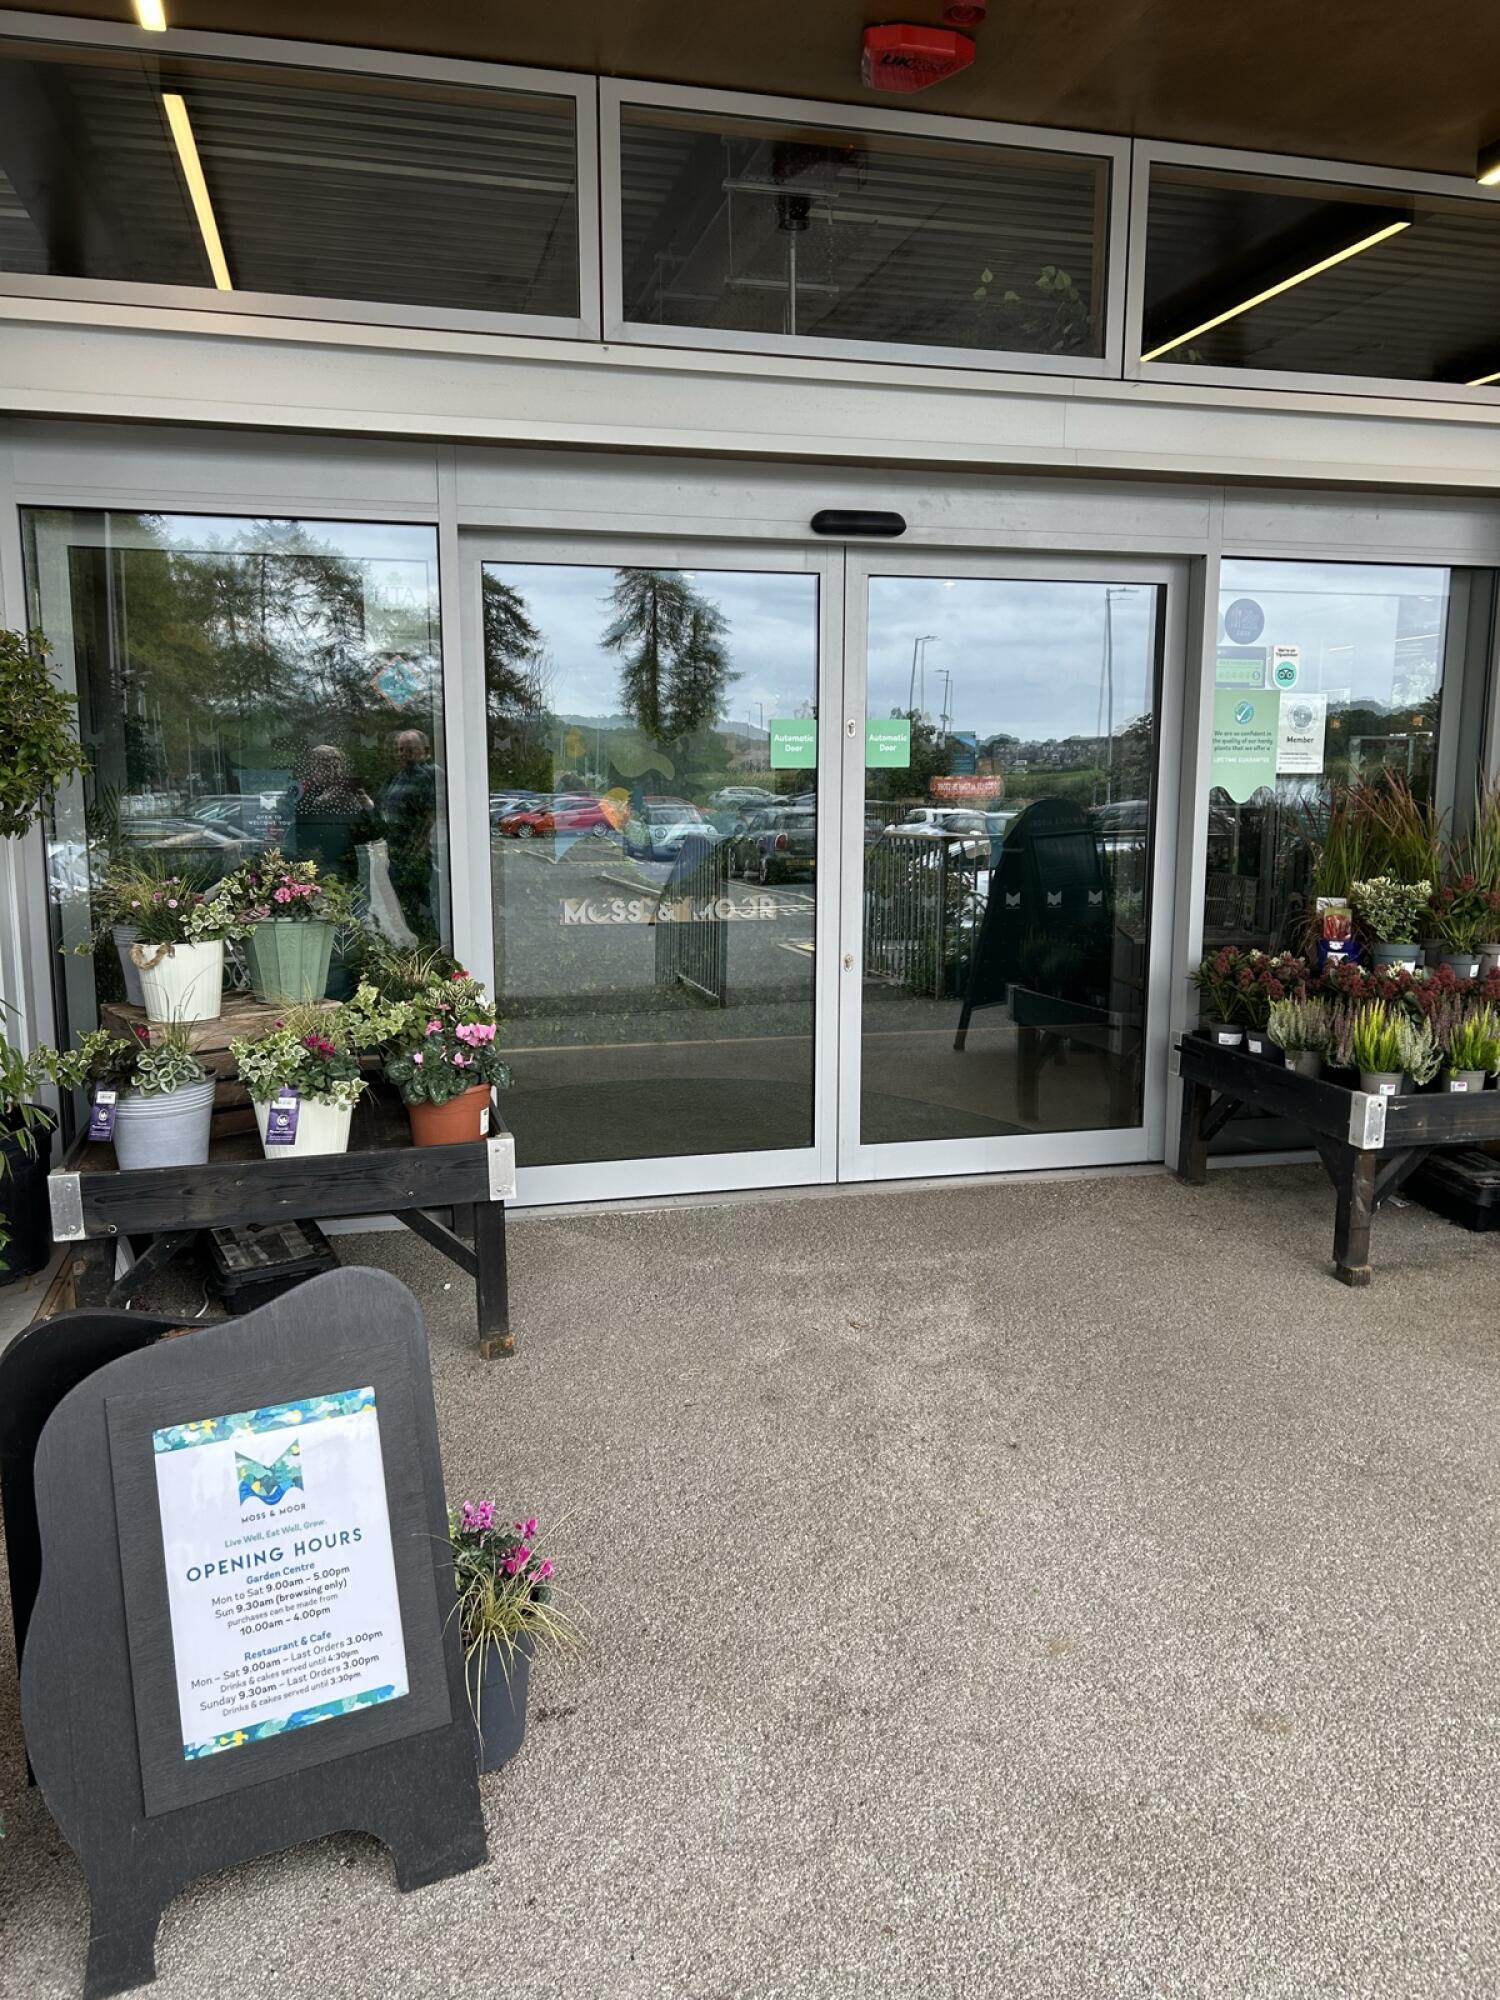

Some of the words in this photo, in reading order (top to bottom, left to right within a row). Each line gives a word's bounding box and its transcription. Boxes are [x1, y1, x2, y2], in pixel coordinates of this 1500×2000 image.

[774, 734, 814, 743] Automatic
[784, 744, 804, 752] Door
[869, 733, 907, 742] Automatic
[879, 743, 898, 752] Door
[1286, 736, 1315, 744] Member
[563, 900, 642, 922] MOSS
[241, 1511, 266, 1524] MOSS
[269, 1509, 276, 1518] &
[279, 1503, 306, 1515] MOOR
[224, 1539, 242, 1549] Live
[243, 1532, 265, 1544] Well,
[266, 1528, 280, 1539] Eat
[281, 1523, 303, 1535] Well,
[186, 1547, 284, 1582] OPENING
[294, 1528, 362, 1557] HOURS
[211, 1595, 233, 1607] Mon
[235, 1591, 246, 1602] to
[247, 1585, 265, 1598] Sat
[266, 1577, 304, 1593] 9.00am
[313, 1566, 350, 1582] 5.00pm
[246, 1571, 281, 1585] Garden
[283, 1562, 315, 1576] Centre
[214, 1607, 235, 1619] Sun
[235, 1597, 274, 1614] 9.30am
[275, 1585, 323, 1606] (browsing
[324, 1578, 347, 1592] only)
[226, 1612, 269, 1629] purchases
[269, 1607, 284, 1617] can
[284, 1603, 296, 1612] be
[296, 1597, 318, 1609] made
[319, 1592, 339, 1603] from
[239, 1618, 284, 1636] 10.00am
[293, 1606, 331, 1622] 4.00pm
[190, 1678, 213, 1690] Mon
[223, 1669, 241, 1681] Sat
[241, 1658, 281, 1675] 9.00am
[290, 1649, 311, 1662] Last
[313, 1641, 345, 1656] Orders
[345, 1630, 383, 1646] 3.00pm
[243, 1639, 299, 1662] Restaurant
[300, 1636, 308, 1646] &
[309, 1630, 332, 1643] Cafe
[199, 1695, 237, 1712] Sunday
[238, 1683, 278, 1700] 9.30am
[287, 1674, 308, 1687] Last
[309, 1665, 341, 1680] Orders
[343, 1654, 380, 1671] 3.00pm
[219, 1681, 247, 1693] Drinks
[248, 1675, 256, 1685] &
[257, 1671, 281, 1683] cakes
[280, 1662, 307, 1676] served
[308, 1656, 327, 1668] until
[222, 1703, 250, 1717] Drinks
[250, 1700, 258, 1709] &
[258, 1695, 282, 1707] cakes
[283, 1685, 310, 1699] served
[310, 1679, 329, 1692] until
